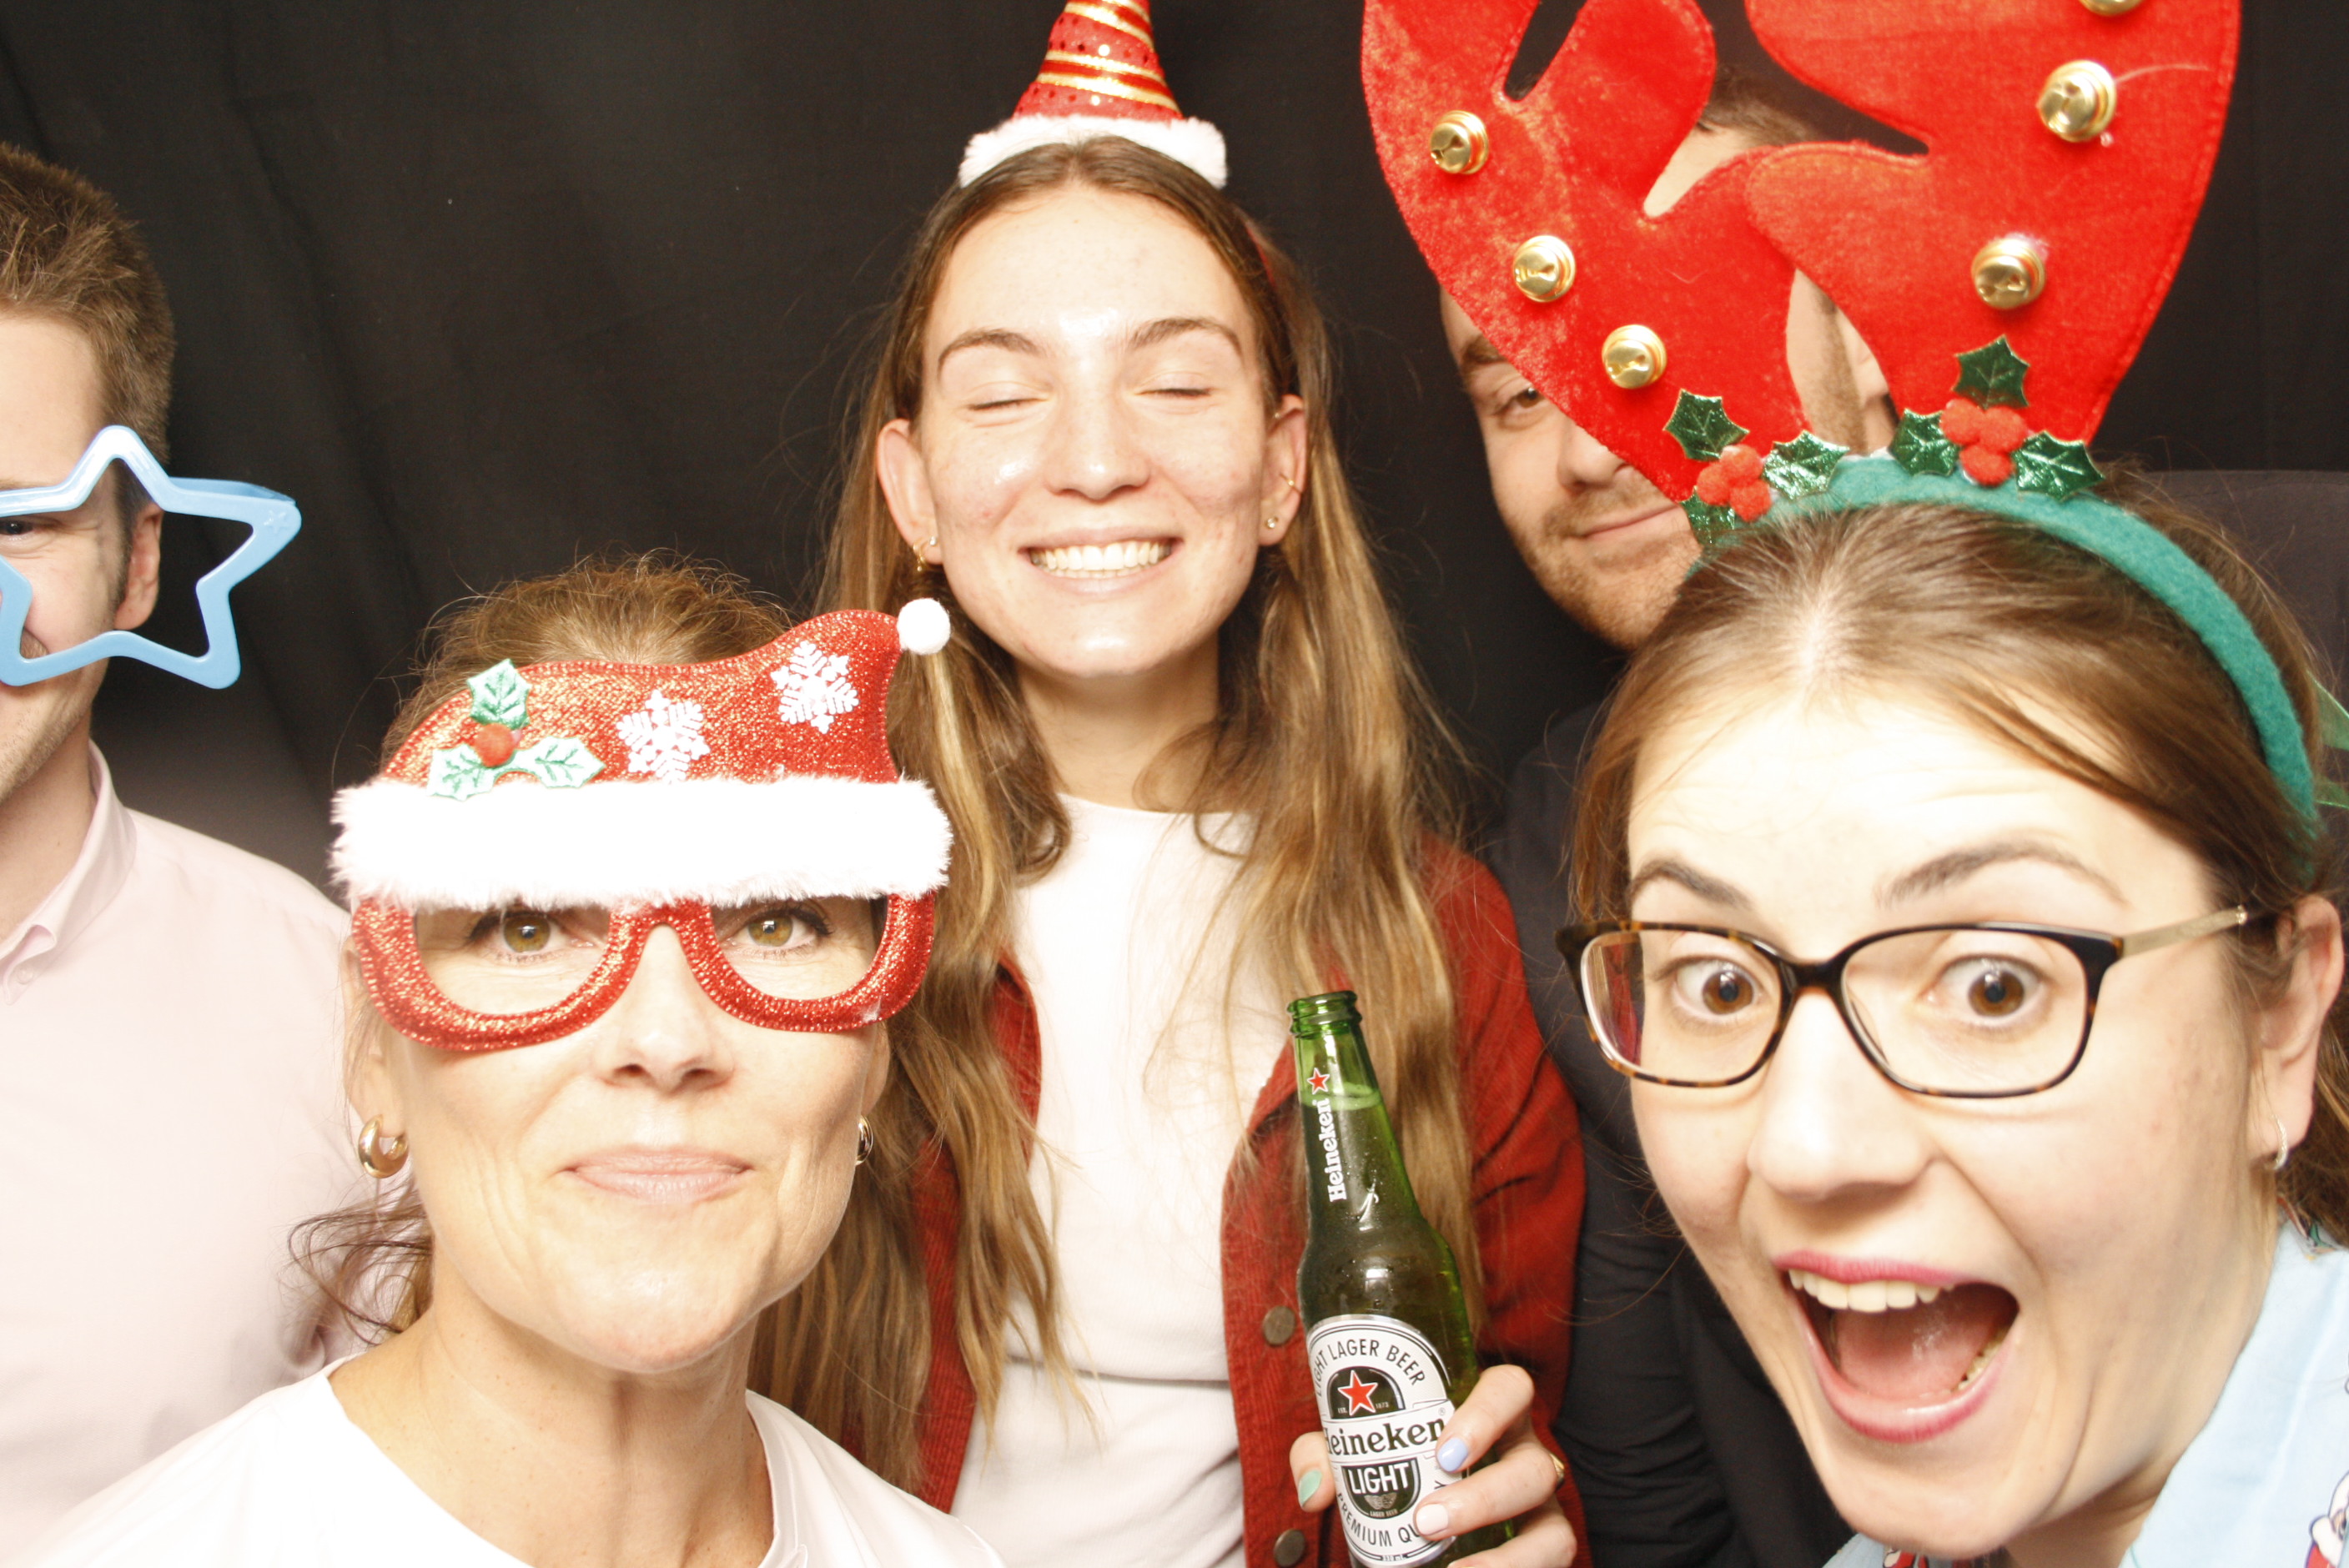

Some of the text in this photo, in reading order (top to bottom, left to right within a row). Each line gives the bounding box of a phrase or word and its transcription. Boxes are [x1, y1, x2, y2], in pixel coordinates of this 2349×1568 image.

[1317, 1098, 1347, 1202] Heineken
[1313, 1339, 1426, 1397] LIGHT LAGER BEER
[1348, 1462, 1410, 1494] LIGHT
[1336, 1492, 1392, 1547] PREMIUM
